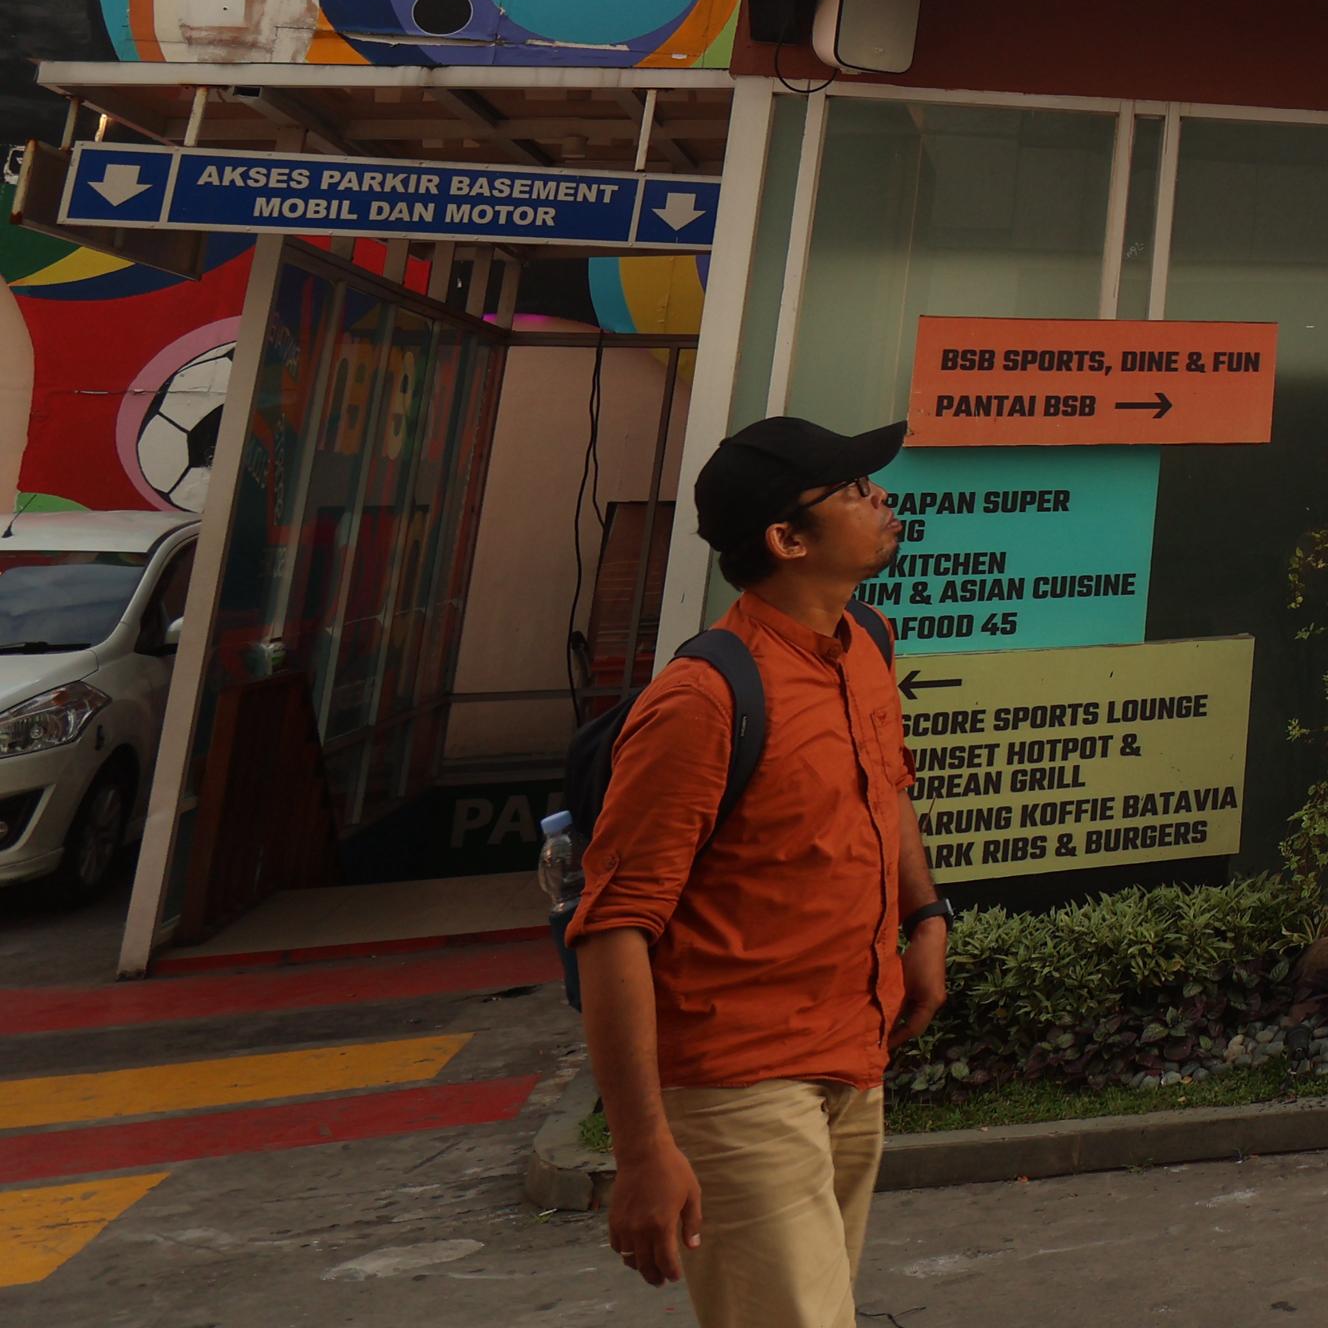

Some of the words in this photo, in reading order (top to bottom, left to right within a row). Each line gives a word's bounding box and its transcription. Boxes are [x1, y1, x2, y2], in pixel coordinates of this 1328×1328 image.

[197, 165, 310, 190] AKSES
[320, 170, 440, 194] PARKIR
[449, 175, 619, 203] BASEMENT
[252, 197, 355, 221] MOBIL
[368, 201, 434, 223] DAN
[443, 203, 556, 226] MOTOR
[940, 349, 995, 372] BSB
[1002, 350, 1112, 376] SPORTS,
[1120, 351, 1179, 373] DINE
[1186, 351, 1206, 373] &
[1213, 352, 1261, 373] FUN
[935, 395, 1036, 418] PANTAI
[1043, 396, 1096, 418] BSB
[983, 489, 1070, 514] SUPER
[888, 551, 1007, 578] KITCHEN
[911, 580, 932, 605] &
[939, 575, 1024, 603] ASIAN
[1032, 573, 1136, 599] CUISINE
[981, 613, 1018, 637] 45
[994, 702, 1099, 730] SPORTS
[1107, 694, 1208, 723] LOUNGE
[914, 743, 1001, 771] UNSET
[1007, 734, 1111, 766] HOTPOT
[1120, 733, 1142, 756] &
[908, 771, 1003, 801] OREAN
[1011, 765, 1086, 794] GRILL
[1019, 796, 1115, 829] KOFFIE
[1122, 786, 1238, 818] BATAVIA
[982, 835, 1047, 862] RIBS
[1055, 833, 1077, 857] &
[1084, 821, 1208, 853] BURGERS
